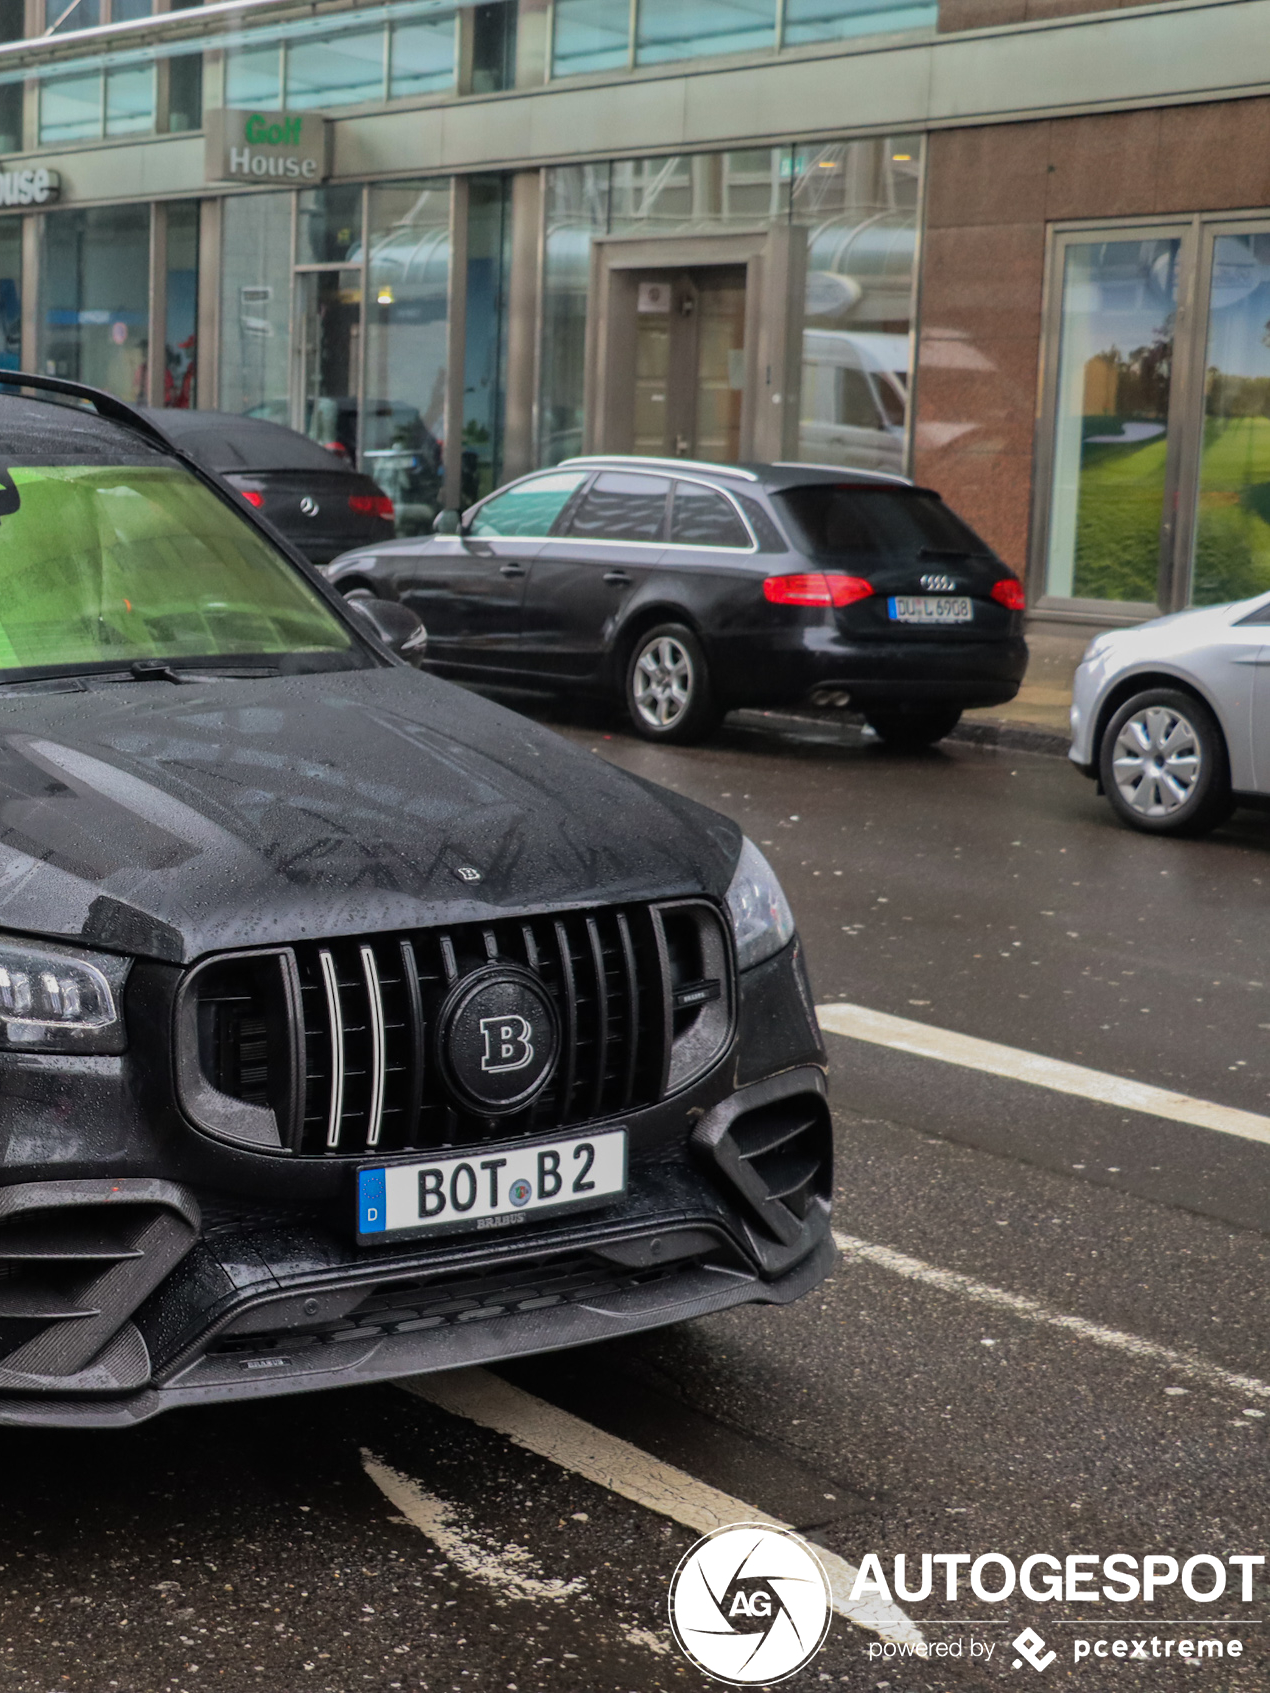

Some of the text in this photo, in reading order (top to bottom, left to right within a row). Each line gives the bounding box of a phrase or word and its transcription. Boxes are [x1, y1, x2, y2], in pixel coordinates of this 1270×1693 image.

[245, 113, 303, 145] Golf
[230, 147, 317, 178] House
[897, 599, 915, 616] DU
[936, 599, 969, 617] 6908
[480, 1014, 534, 1074] B
[417, 1157, 507, 1219] BOT
[367, 1207, 378, 1222] D
[476, 1213, 525, 1230] BRABUS
